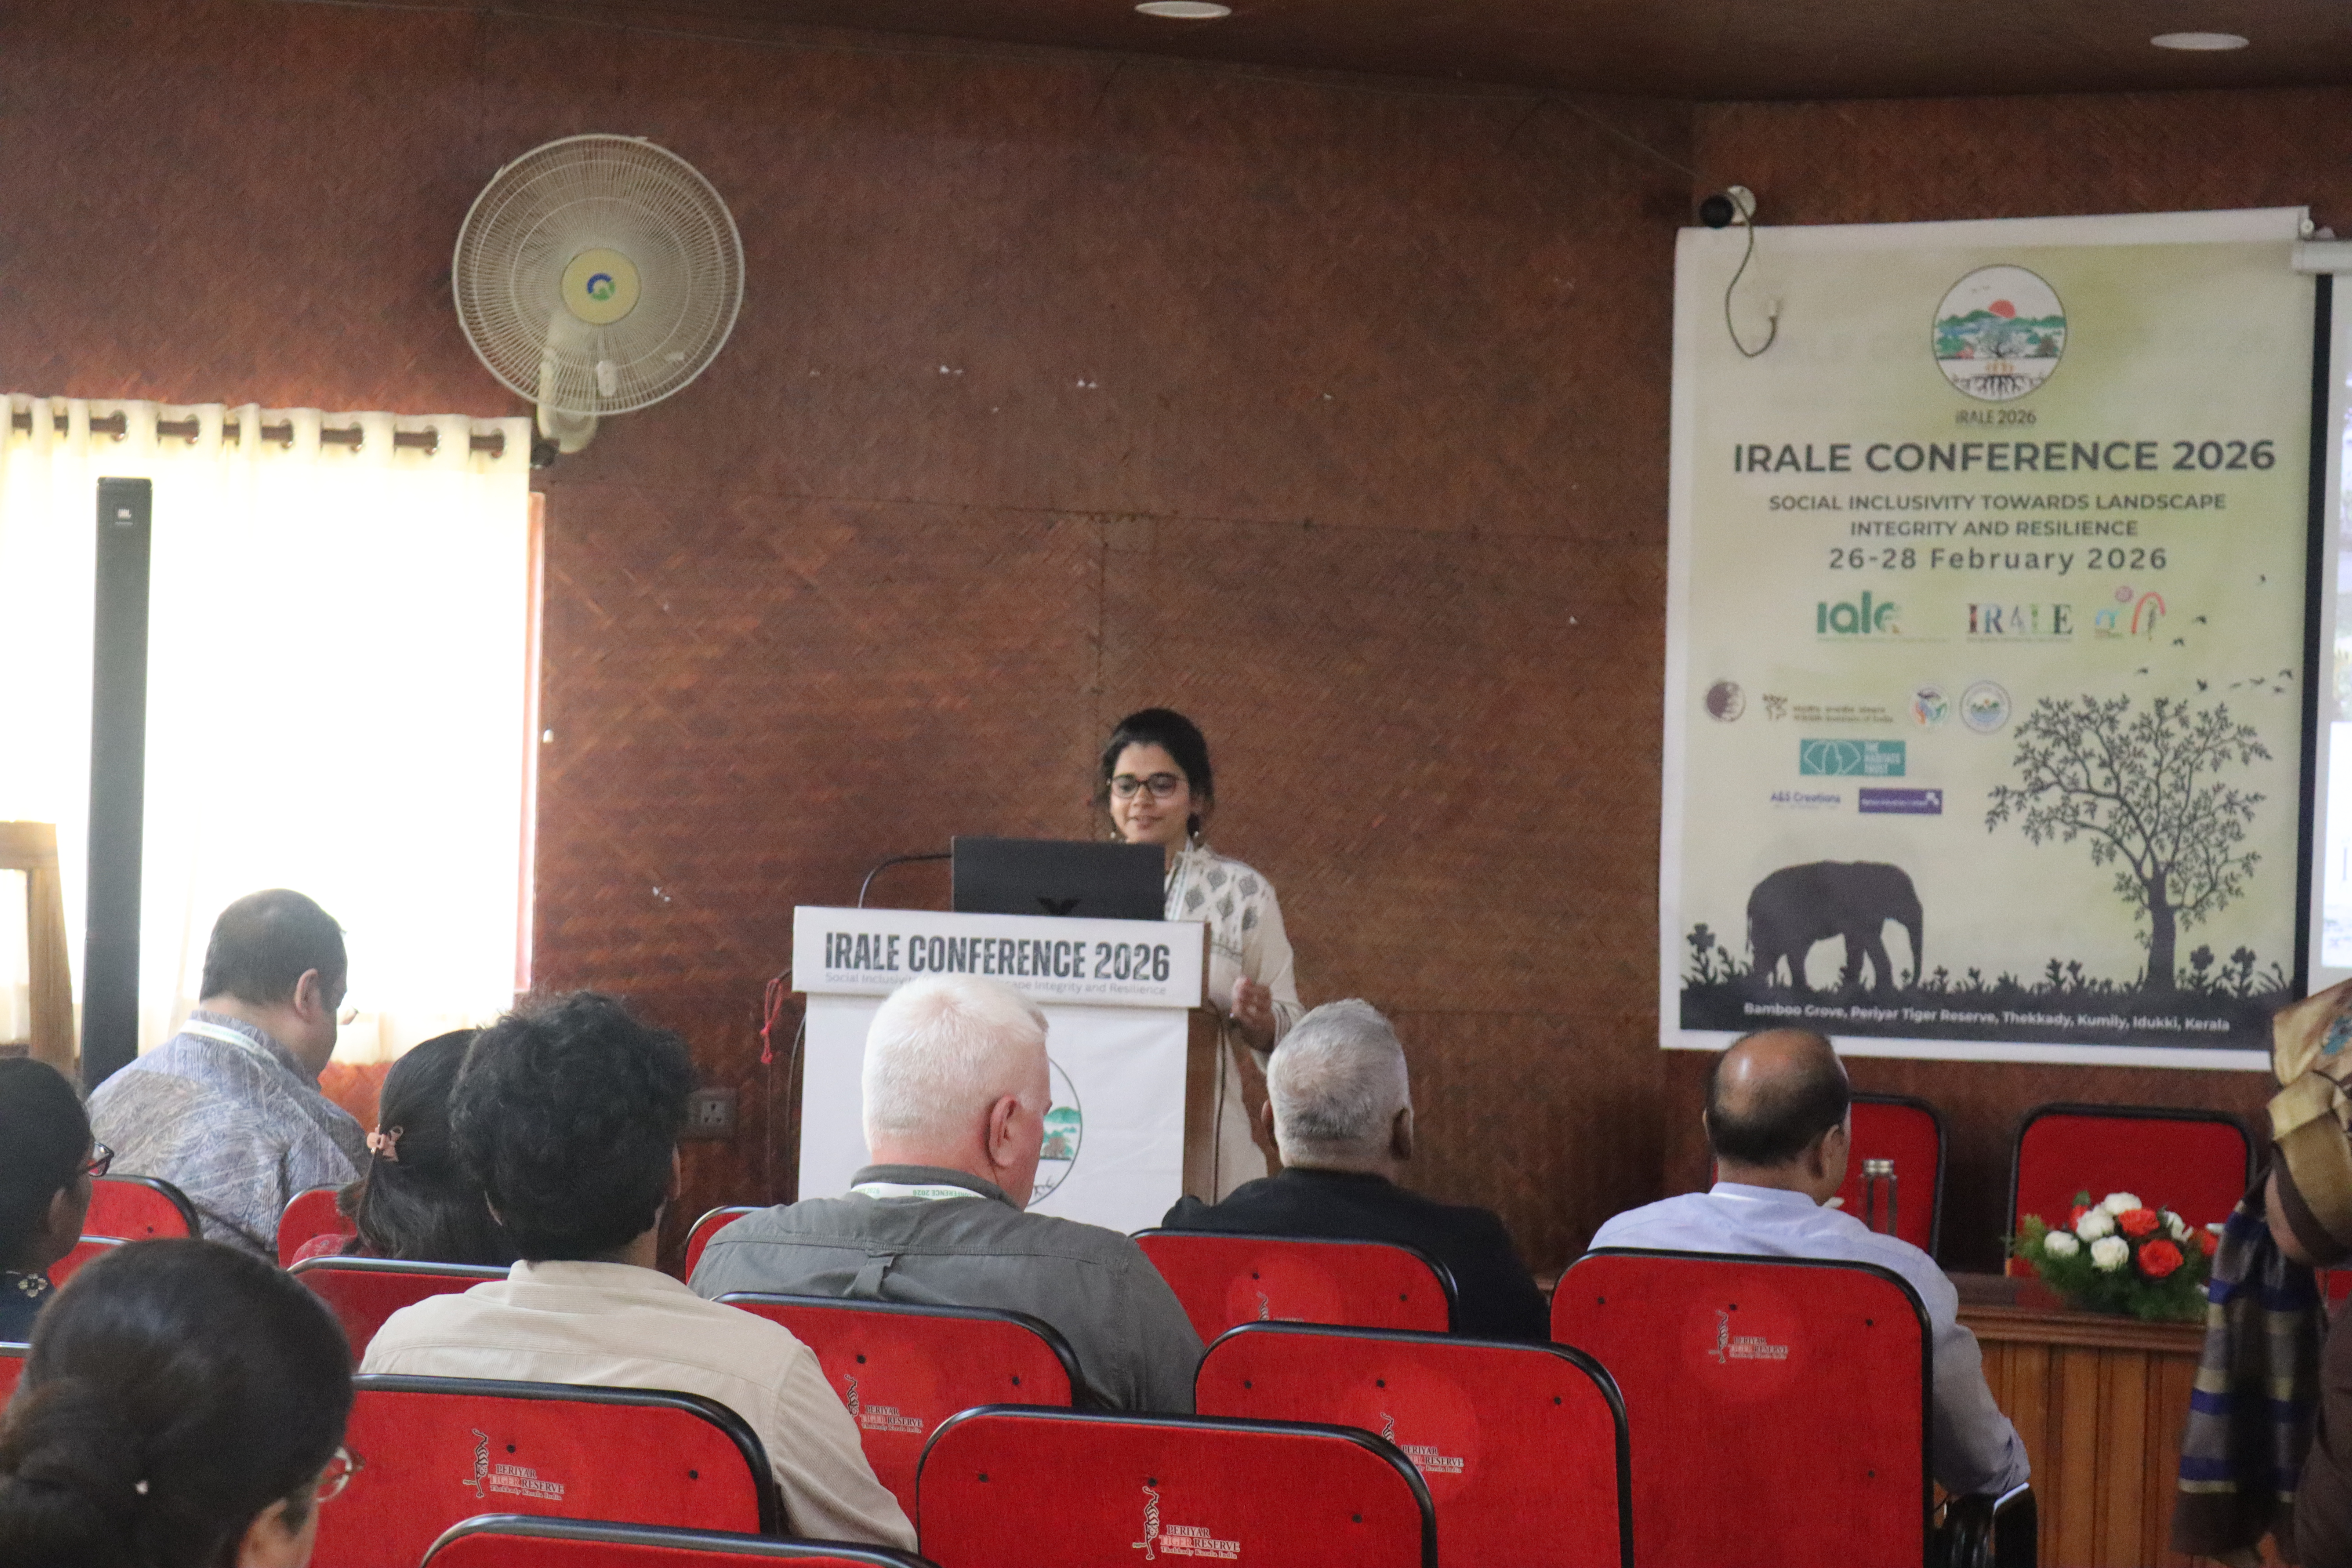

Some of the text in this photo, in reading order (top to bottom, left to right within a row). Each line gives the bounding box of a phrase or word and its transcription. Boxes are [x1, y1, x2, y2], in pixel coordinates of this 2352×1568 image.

[1955, 409, 2037, 424] IRALE 2026
[1734, 439, 2276, 472] IRALE CONFERENCE 2026
[1769, 494, 2226, 510] SOCIAL INCLUSIVITY TOWARDS LANDSCAPE
[1851, 521, 2138, 536] INTEGRITY AND RESILIENCE
[1829, 547, 2167, 575] 26-28 February 2026
[826, 932, 1170, 981] IRALE CONFERENCE 2026
[826, 971, 916, 985] Social Inclusivi
[1034, 980, 1081, 994] Integrity
[1085, 982, 1106, 993] and
[1110, 984, 1166, 995] Resilience
[1744, 1002, 1802, 1017] Bamboo
[1804, 1004, 1848, 1019] Grove,
[1850, 1005, 1898, 1022] Periyar
[1901, 1007, 1938, 1024] Tiger
[1939, 1009, 1999, 1025] Reserve,
[2002, 1011, 2075, 1029] Thekkady,
[2184, 1017, 2230, 1033] Kerala
[865, 1406, 899, 1415] PERIYAR
[887, 1417, 923, 1427] RESERVE
[1402, 1445, 1438, 1455] PERIYAR
[1425, 1456, 1464, 1467] RESERVE
[496, 1464, 536, 1478] PERIYAR
[490, 1474, 520, 1486] TIGER
[521, 1479, 564, 1494] RESERVE
[1167, 1525, 1210, 1538] PERIYAR
[1159, 1535, 1194, 1548] TIGER
[1194, 1538, 1240, 1552] RESERVE
